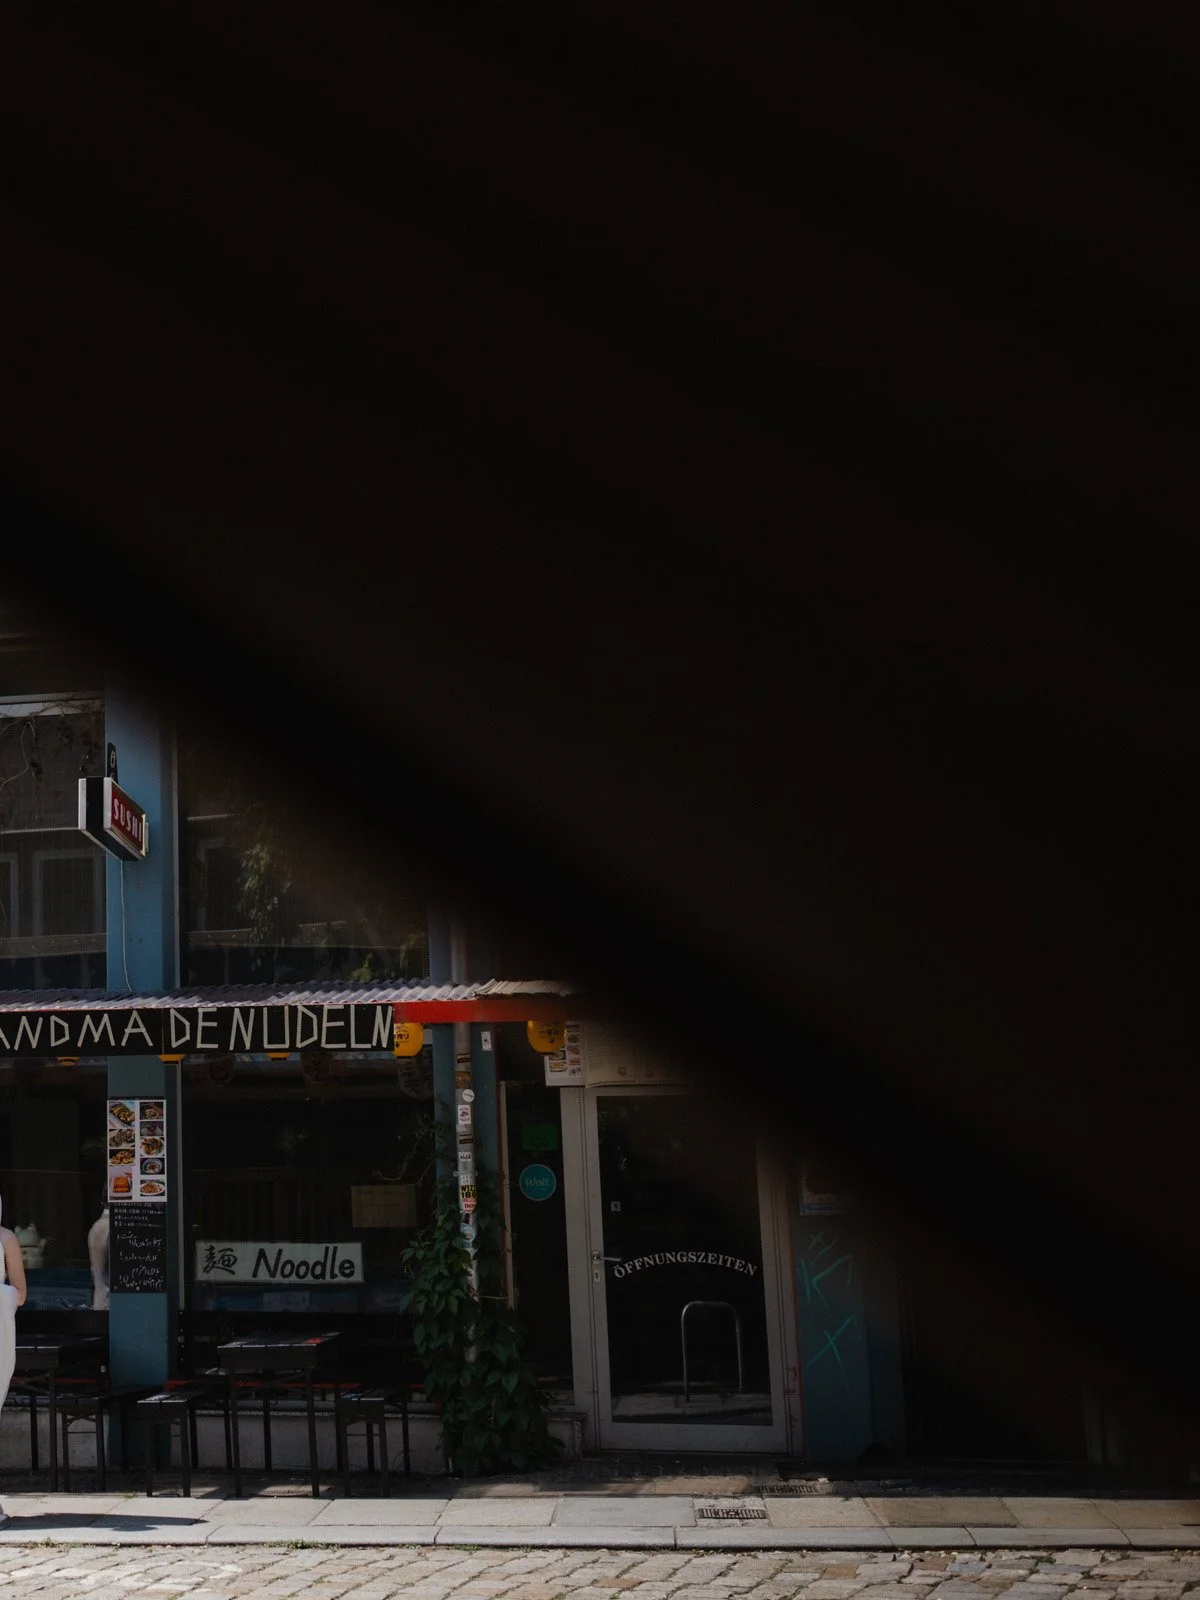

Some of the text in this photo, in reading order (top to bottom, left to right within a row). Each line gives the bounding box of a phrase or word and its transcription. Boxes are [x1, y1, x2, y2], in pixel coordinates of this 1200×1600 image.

[113, 798, 142, 842] SUSHI
[524, 1175, 549, 1187] Wolt
[251, 1245, 355, 1280] Noodle
[613, 1251, 758, 1279] ÖFFNUNGSZEITEN
